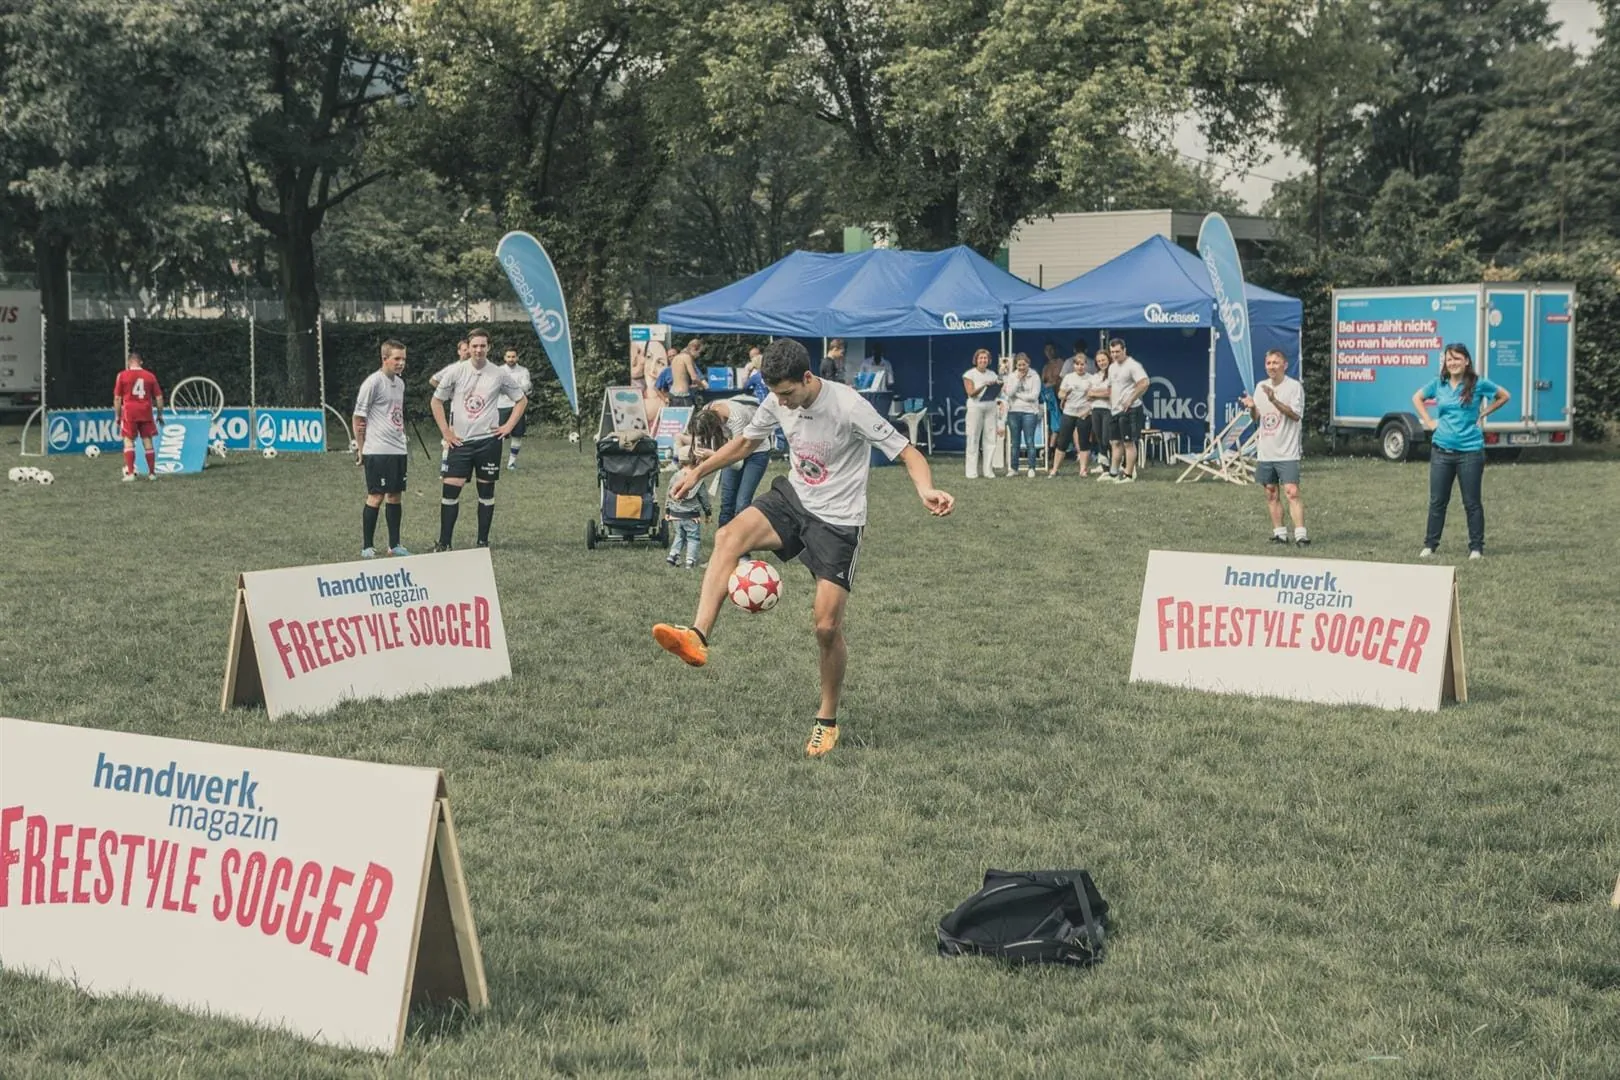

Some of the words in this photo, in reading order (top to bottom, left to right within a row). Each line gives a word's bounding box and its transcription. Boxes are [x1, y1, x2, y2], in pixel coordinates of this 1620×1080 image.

[1169, 312, 1200, 323] classic
[1356, 323, 1376, 333] uns
[1377, 320, 1402, 333] zählt
[1404, 320, 1435, 333] nicht,
[1338, 340, 1356, 349] wo
[1357, 339, 1380, 349] man
[1381, 336, 1441, 349] herkommt.
[1338, 353, 1381, 364] Sondern
[1382, 355, 1400, 364] wo
[1402, 354, 1426, 364] man
[132, 378, 146, 399] 4
[76, 419, 121, 444] JAKO
[157, 424, 186, 461] JAKO
[279, 418, 322, 444] JAKO
[370, 585, 429, 608] magazin
[1276, 588, 1353, 610] magazin
[269, 611, 405, 680] FREESTYLE
[406, 596, 492, 649] SOCCER
[1157, 596, 1305, 652] FREESTYLE
[1311, 612, 1431, 674] SOCCER
[168, 800, 279, 842] magazin
[0, 805, 208, 915] FREESTYLE
[213, 847, 394, 975] SOCCER
